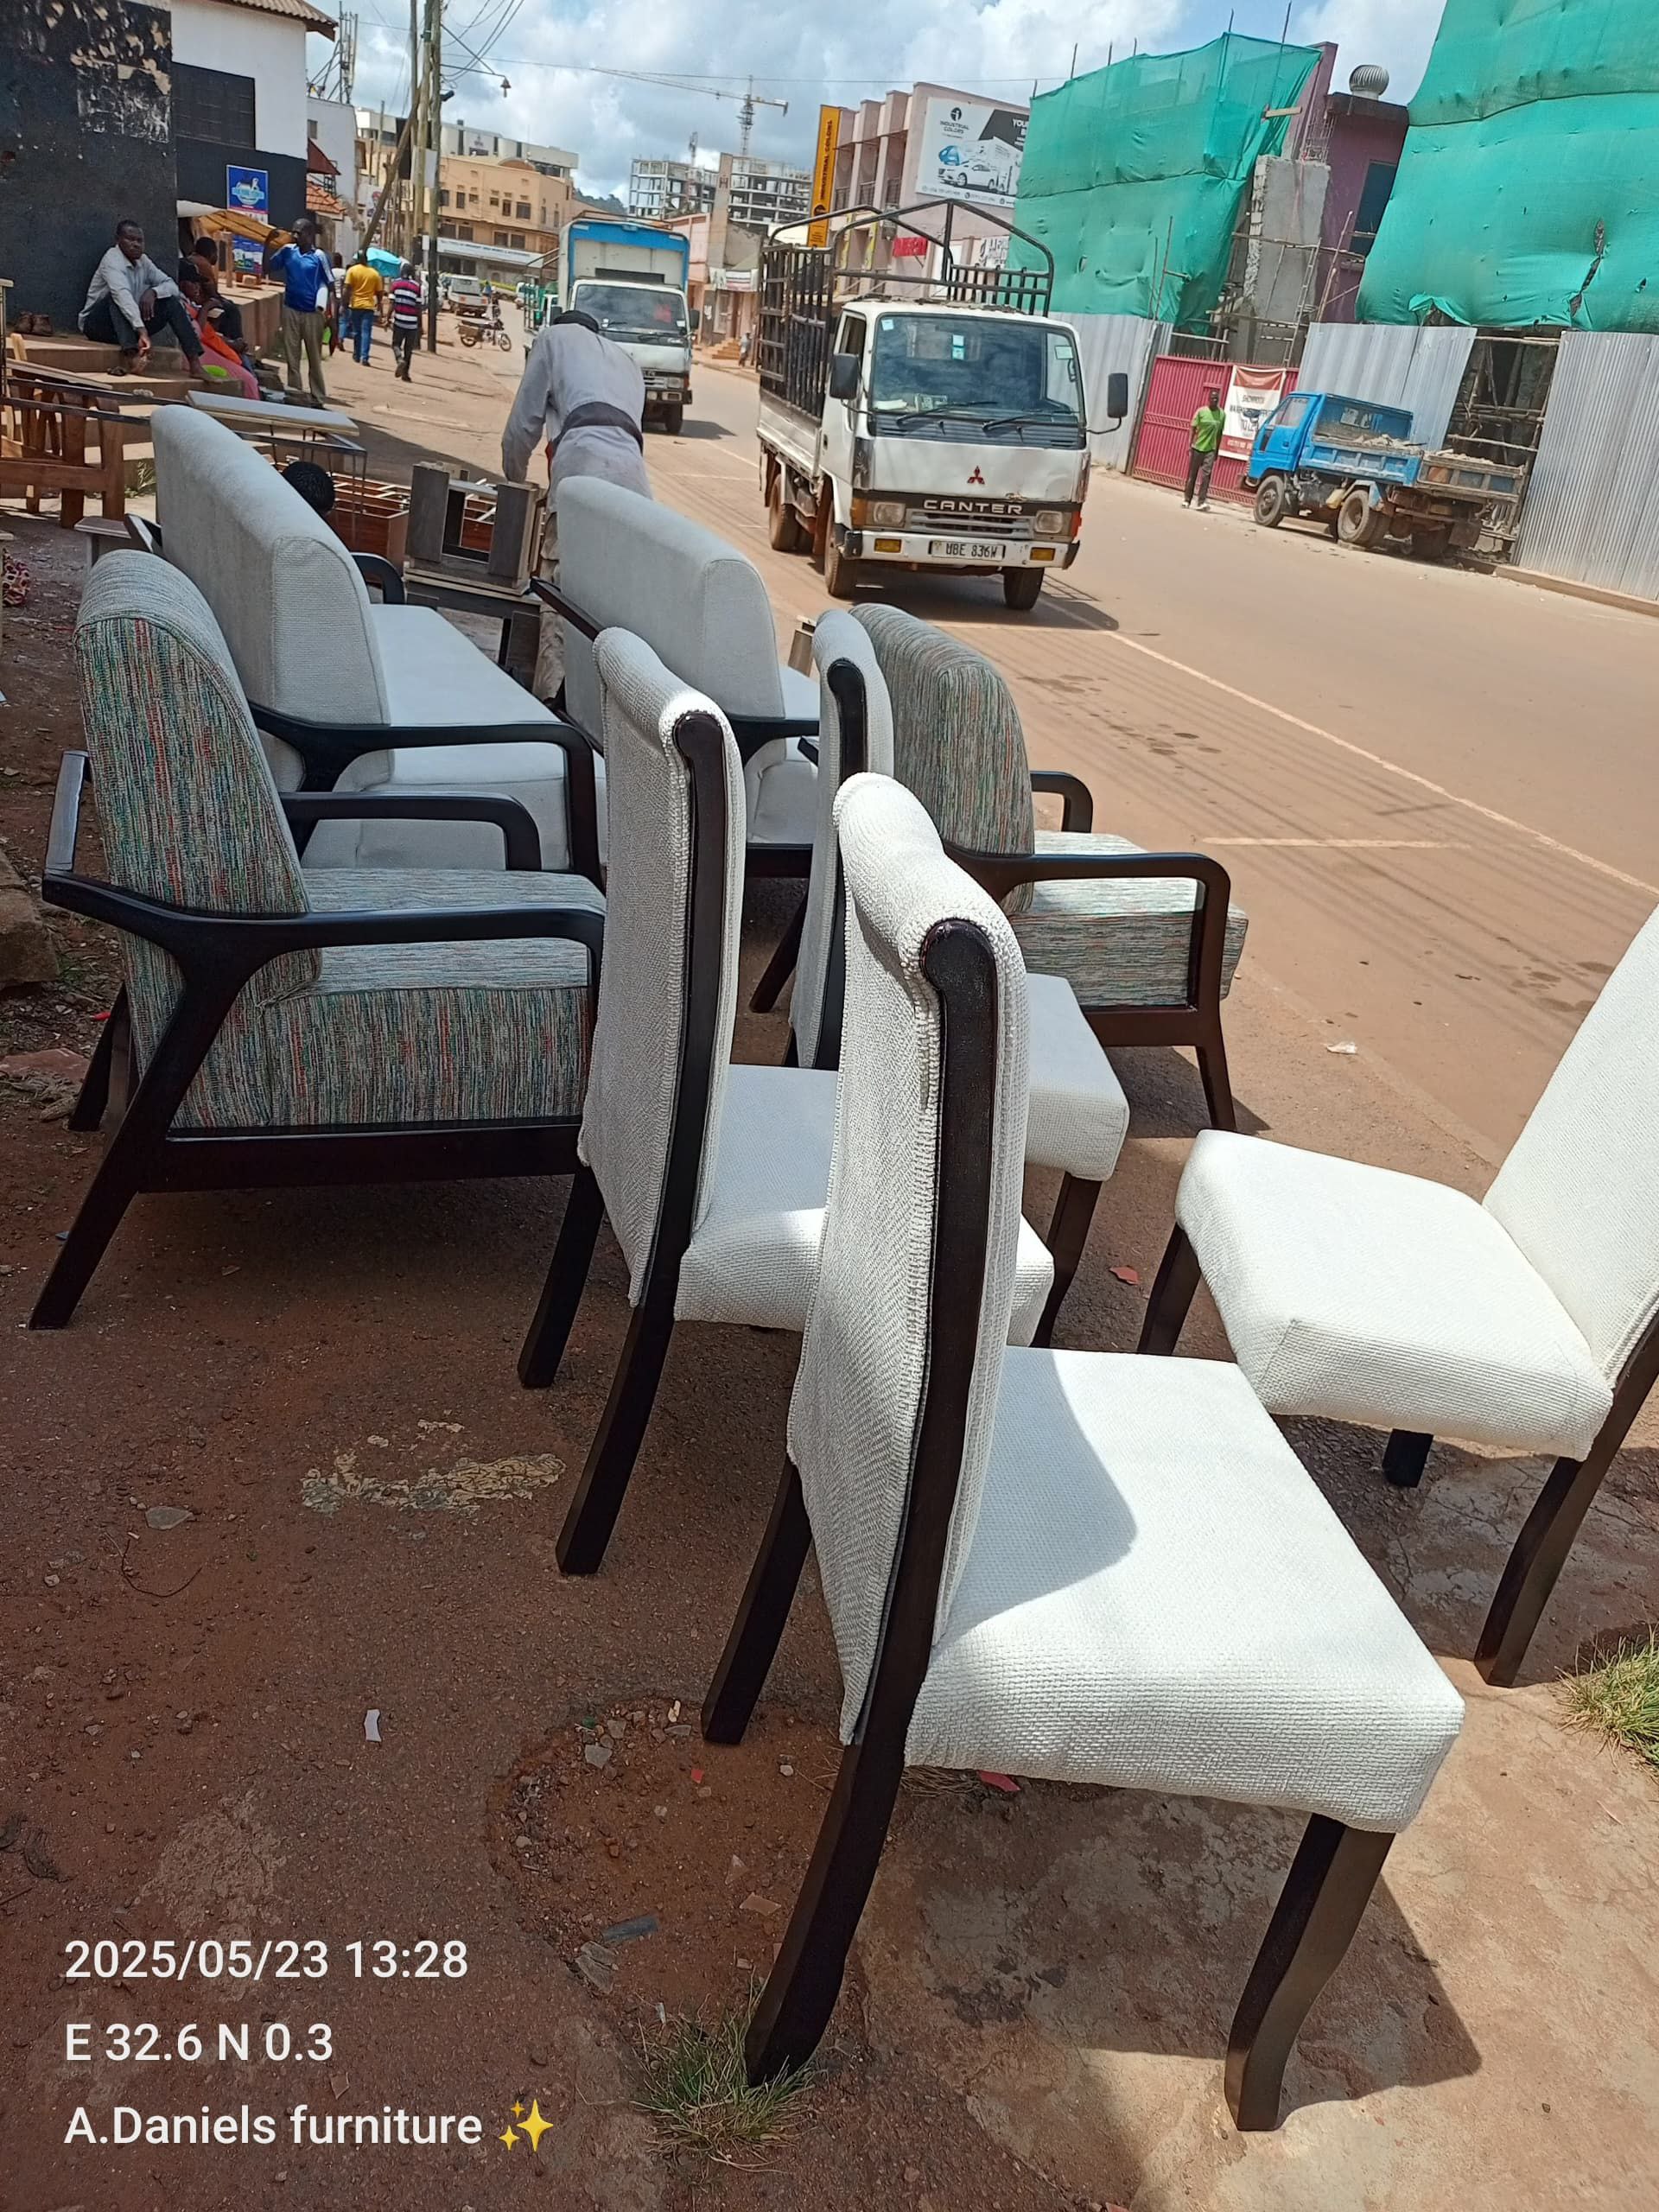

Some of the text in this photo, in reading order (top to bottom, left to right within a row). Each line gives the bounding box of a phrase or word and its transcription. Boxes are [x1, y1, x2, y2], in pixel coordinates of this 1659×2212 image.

[820, 119, 833, 200] INDUSTRIAL COLORS
[924, 499, 1023, 515] CANTER
[945, 543, 998, 558] UBE 836W
